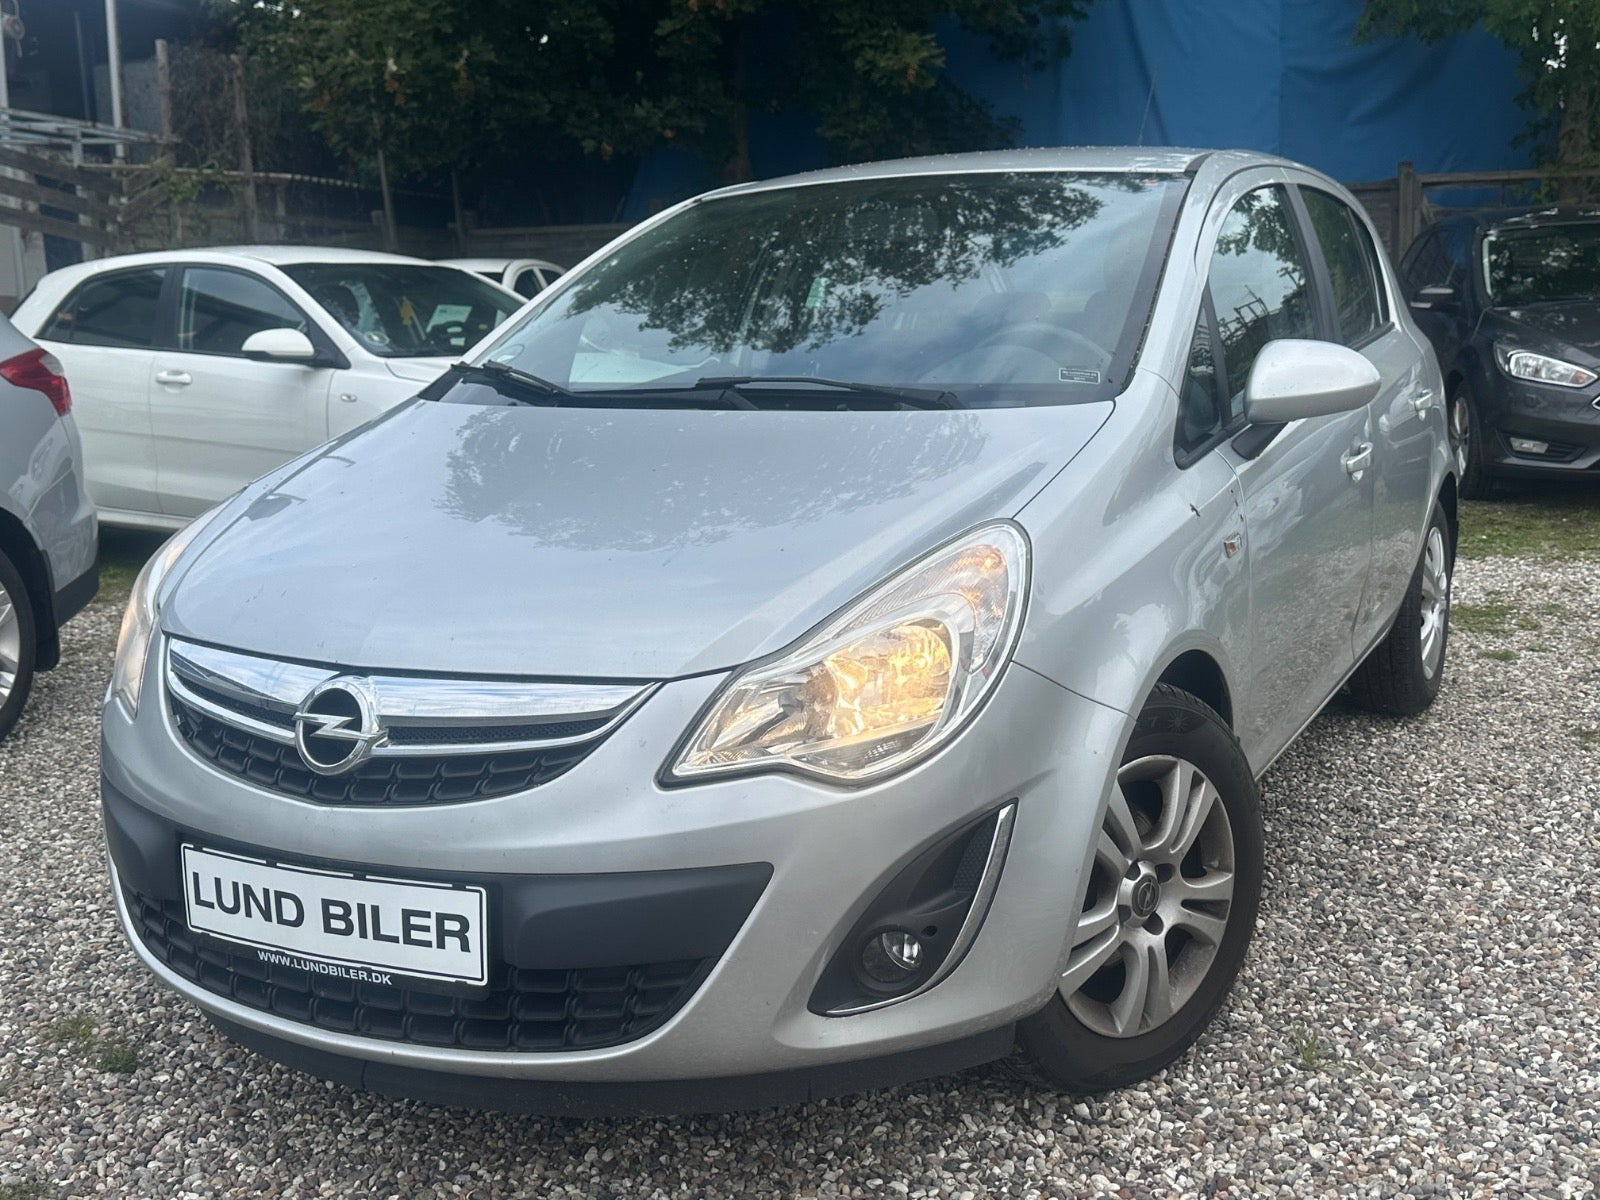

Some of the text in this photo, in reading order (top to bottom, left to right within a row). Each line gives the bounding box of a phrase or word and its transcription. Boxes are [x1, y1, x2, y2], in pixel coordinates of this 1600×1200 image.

[192, 871, 471, 953] LUND BILER
[257, 950, 393, 986] WWW.LUNDBILER.DK
